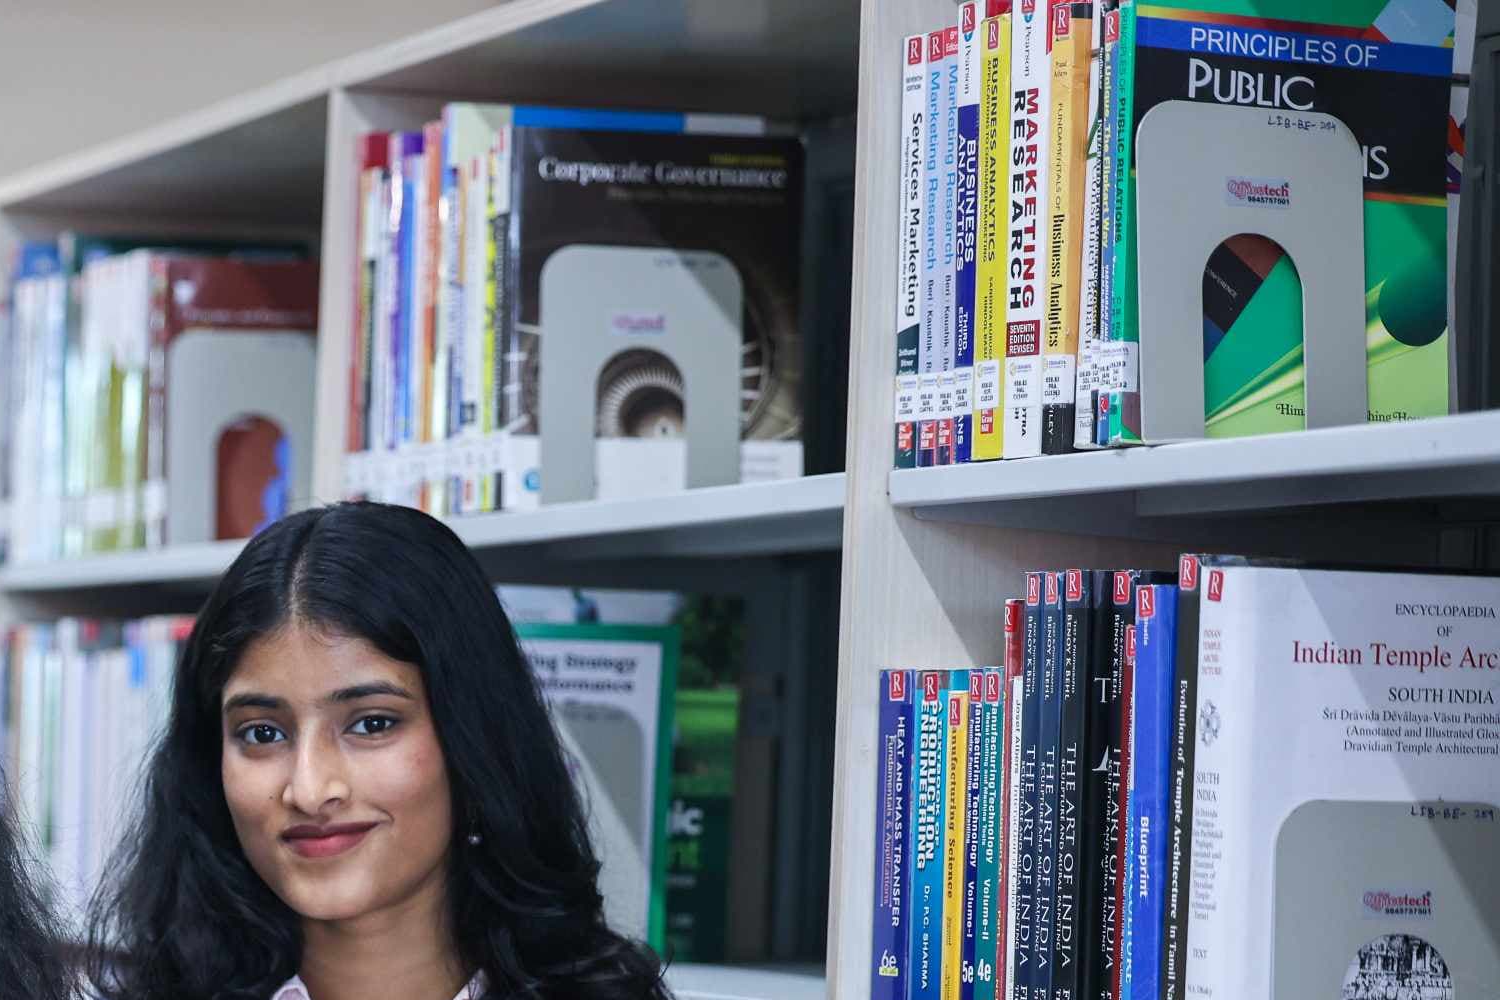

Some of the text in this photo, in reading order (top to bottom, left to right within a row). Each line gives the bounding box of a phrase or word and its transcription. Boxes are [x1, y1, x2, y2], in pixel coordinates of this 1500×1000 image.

[1023, 26, 1032, 77] Pearson
[1190, 27, 1379, 68] PRINCIPLES OF
[1188, 57, 1315, 111] PUBLIC
[1055, 103, 1063, 193] FUNDAMENTALS
[1117, 97, 1126, 153] PUBLIC
[538, 155, 651, 186] Corporate
[655, 160, 788, 188] Governance
[927, 71, 940, 270] Marketing Research
[944, 65, 958, 264] Marketing Research
[988, 57, 998, 262] BUSINESS ANALYTICS
[905, 113, 922, 317] Services Marketing
[956, 134, 966, 271] ANALYTICS
[965, 139, 976, 262] BUSINESS
[1010, 90, 1026, 309] RESEARCH
[1022, 87, 1039, 308] MARKETING
[1114, 158, 1125, 243] RELATIONS
[1051, 214, 1065, 277] Business
[1010, 323, 1035, 333] SEVENTH
[1010, 333, 1035, 343] EDITION
[1048, 282, 1063, 347] Analytics
[1009, 343, 1035, 353] REVISED
[1065, 614, 1073, 654] BENOY
[1395, 603, 1496, 619] ENCYCLOPAEDIA
[1436, 625, 1454, 638] OF
[1292, 640, 1500, 674] Indian Temple Arc
[1177, 679, 1188, 745] Evolution
[1388, 687, 1495, 705] SOUTH INDIA
[1177, 749, 1185, 763] of
[1343, 740, 1499, 755] Dravidian Temple Architectural
[1346, 726, 1401, 739] (Annotated
[1404, 727, 1422, 738] and
[1425, 727, 1474, 740] Illustrated
[885, 735, 896, 816] Fundamentals
[917, 699, 930, 870] ENGINEERING
[925, 701, 938, 859] PRODUCTION
[935, 719, 943, 817] TEXTBOOK
[1112, 746, 1122, 792] THE
[1173, 767, 1185, 823] Temple
[891, 716, 905, 927] HEAT AND MASS TRANSFER
[947, 726, 959, 898] anufacturing Science
[970, 795, 980, 867] Technology
[986, 790, 997, 865] Technology
[1110, 800, 1120, 842] ART
[883, 833, 892, 904] Applications
[1019, 744, 1036, 965] THE ART OF INDIA
[1038, 745, 1055, 969] THE ART OF INDIA
[1061, 742, 1077, 969] THE ART OF INDIA
[1138, 815, 1150, 899] Blueprint
[1169, 825, 1182, 919] Architecture
[966, 880, 975, 938] Volume-I
[981, 879, 991, 940] Volume-II
[1055, 895, 1063, 951] PAINTING
[1105, 896, 1116, 970] INDIA
[1169, 925, 1178, 939] in
[880, 949, 897, 969] 6e
[921, 933, 929, 989] SHARMA
[962, 960, 974, 983] 5e
[977, 957, 992, 982] 4e
[1167, 942, 1177, 980] Tamil
